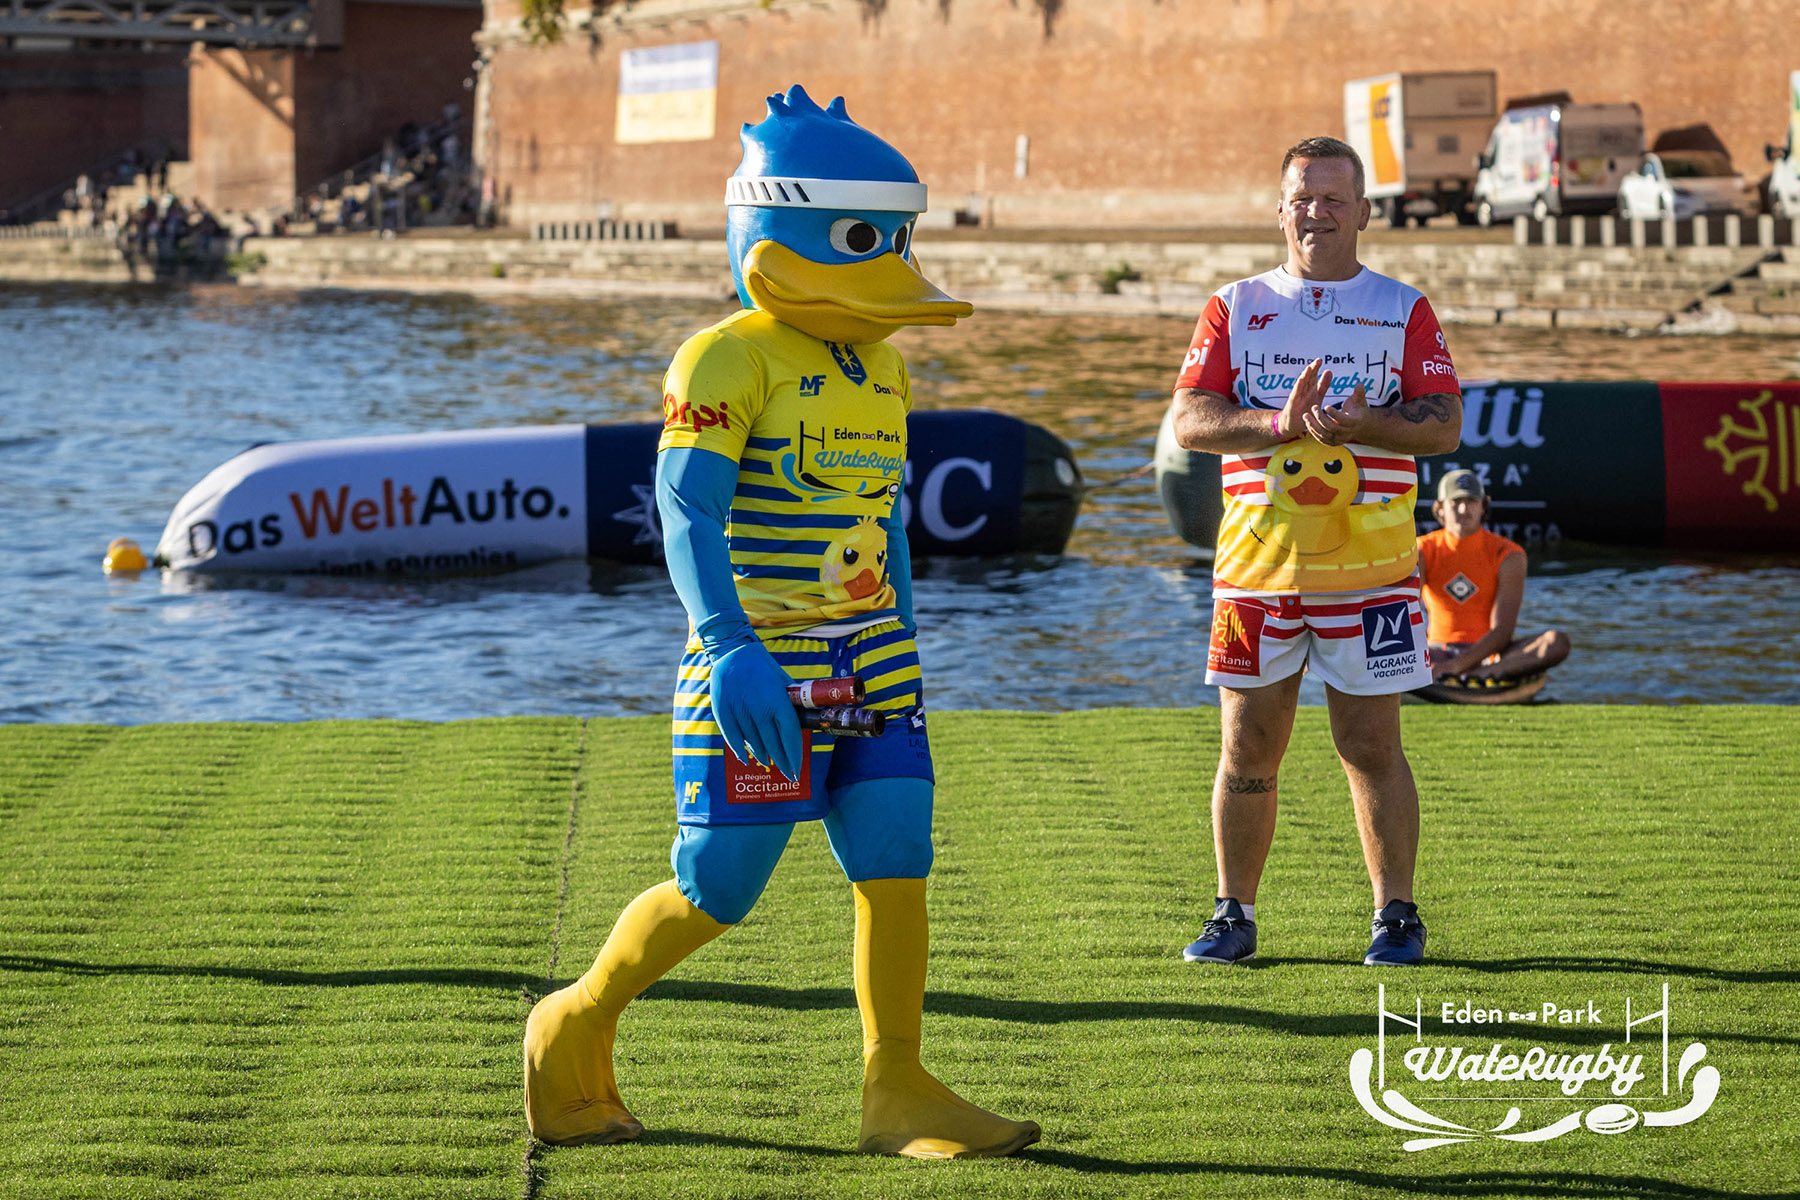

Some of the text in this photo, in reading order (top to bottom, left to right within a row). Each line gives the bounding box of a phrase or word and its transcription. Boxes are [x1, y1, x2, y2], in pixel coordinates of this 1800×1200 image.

[1335, 315, 1355, 325] Das
[1181, 338, 1210, 376] pi
[1274, 352, 1355, 365] Eden Park
[873, 383, 891, 395] Das
[1461, 387, 1545, 448] tti
[834, 427, 900, 443] Eden Park
[187, 512, 283, 559] Das
[1367, 654, 1417, 670] LAGRANGE
[1374, 666, 1414, 678] vacances
[735, 781, 800, 793] Occitanie
